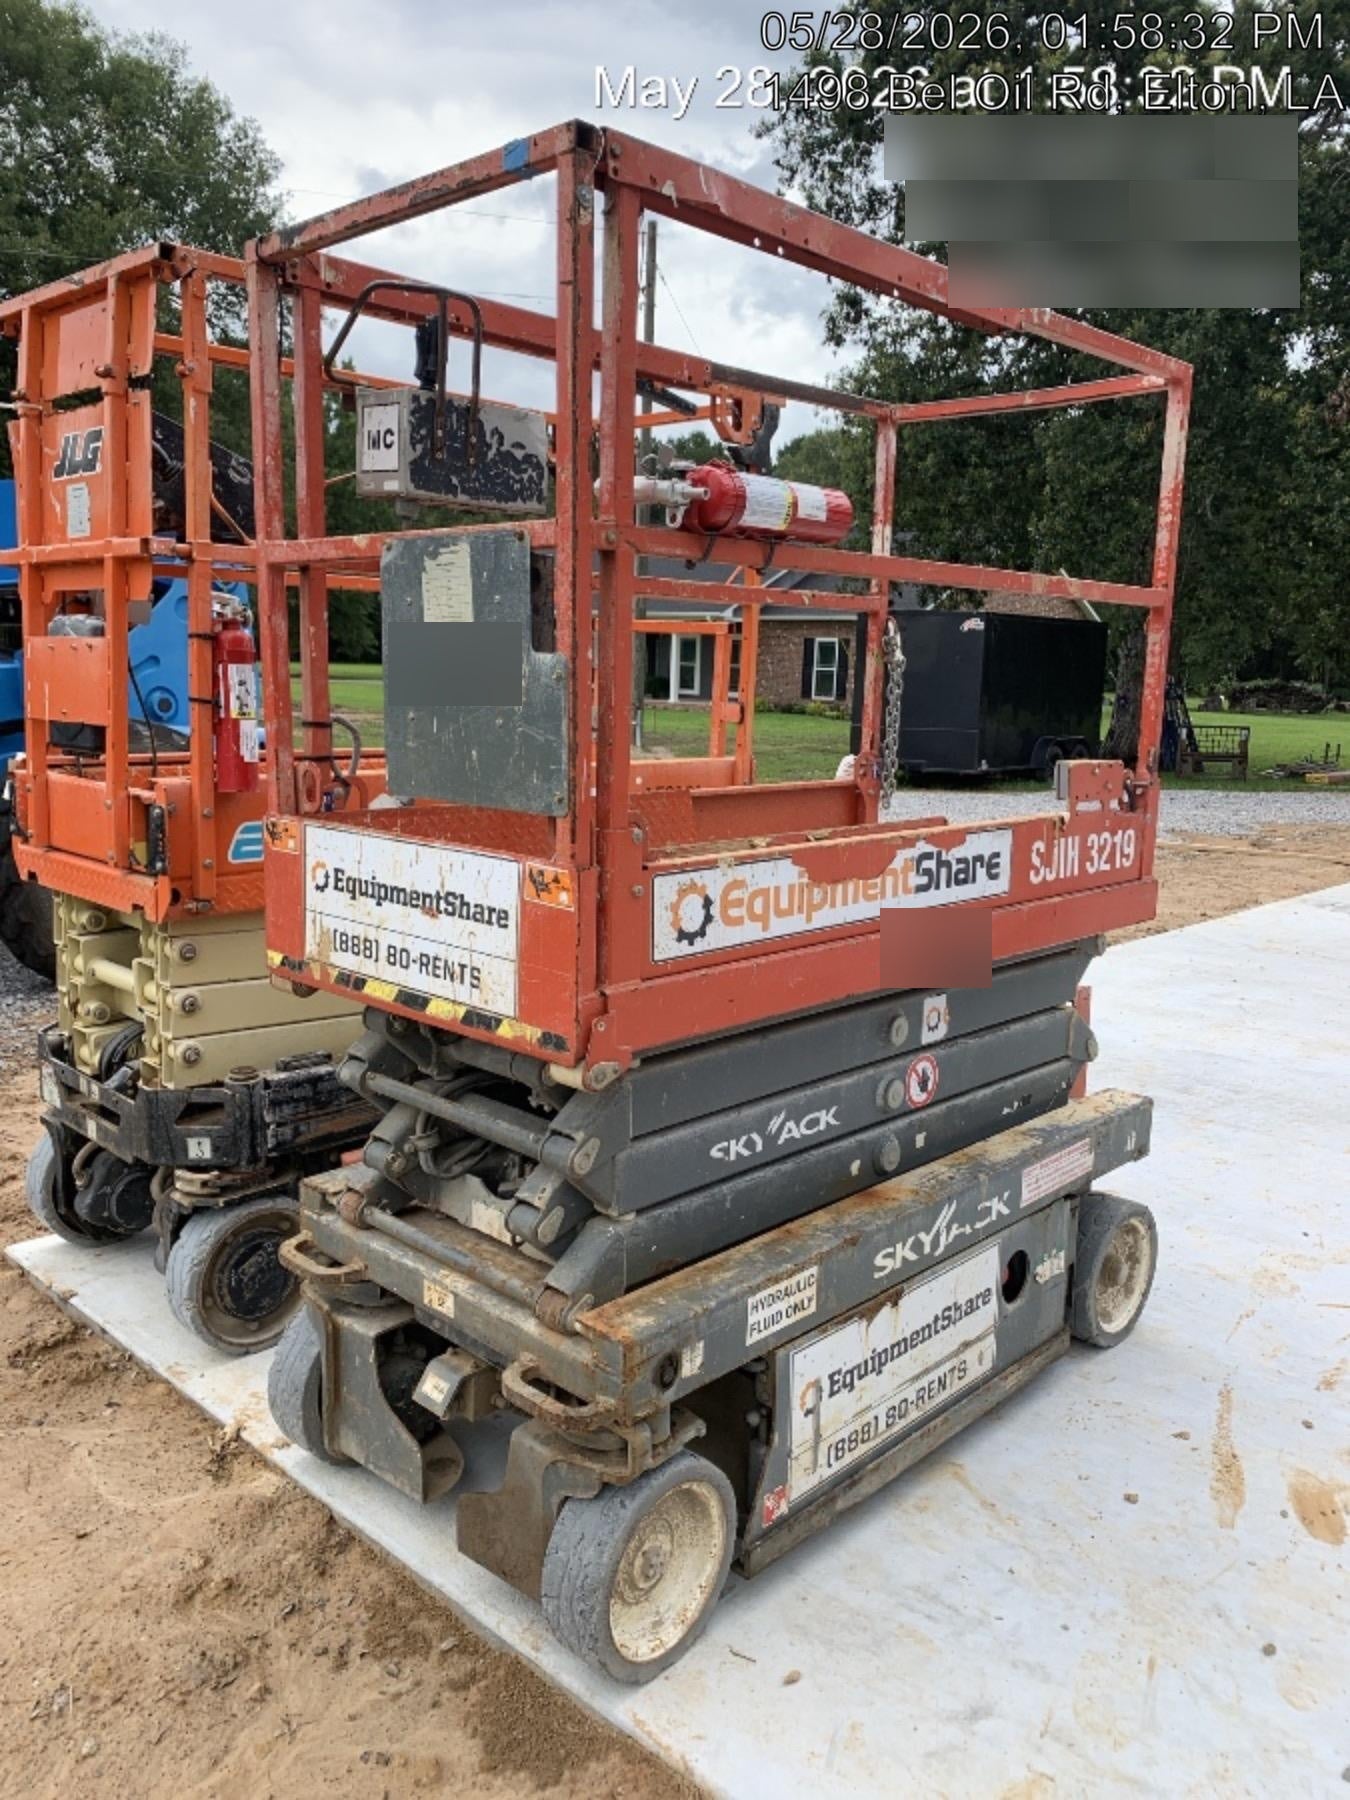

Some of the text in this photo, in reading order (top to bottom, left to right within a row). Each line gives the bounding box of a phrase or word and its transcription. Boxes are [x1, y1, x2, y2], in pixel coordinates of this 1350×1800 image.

[53, 426, 104, 481] JLG
[1085, 828, 1136, 875] 3219
[333, 867, 509, 929] EquipmentShare
[719, 850, 1001, 932] EquipmentShare
[387, 945, 481, 989] 80-RENTS
[750, 1273, 815, 1316] HYDRAULIC
[749, 1310, 783, 1339] FLUID
[827, 1287, 993, 1399] EquipmentShare
[885, 1359, 968, 1429] 80-RENTS
